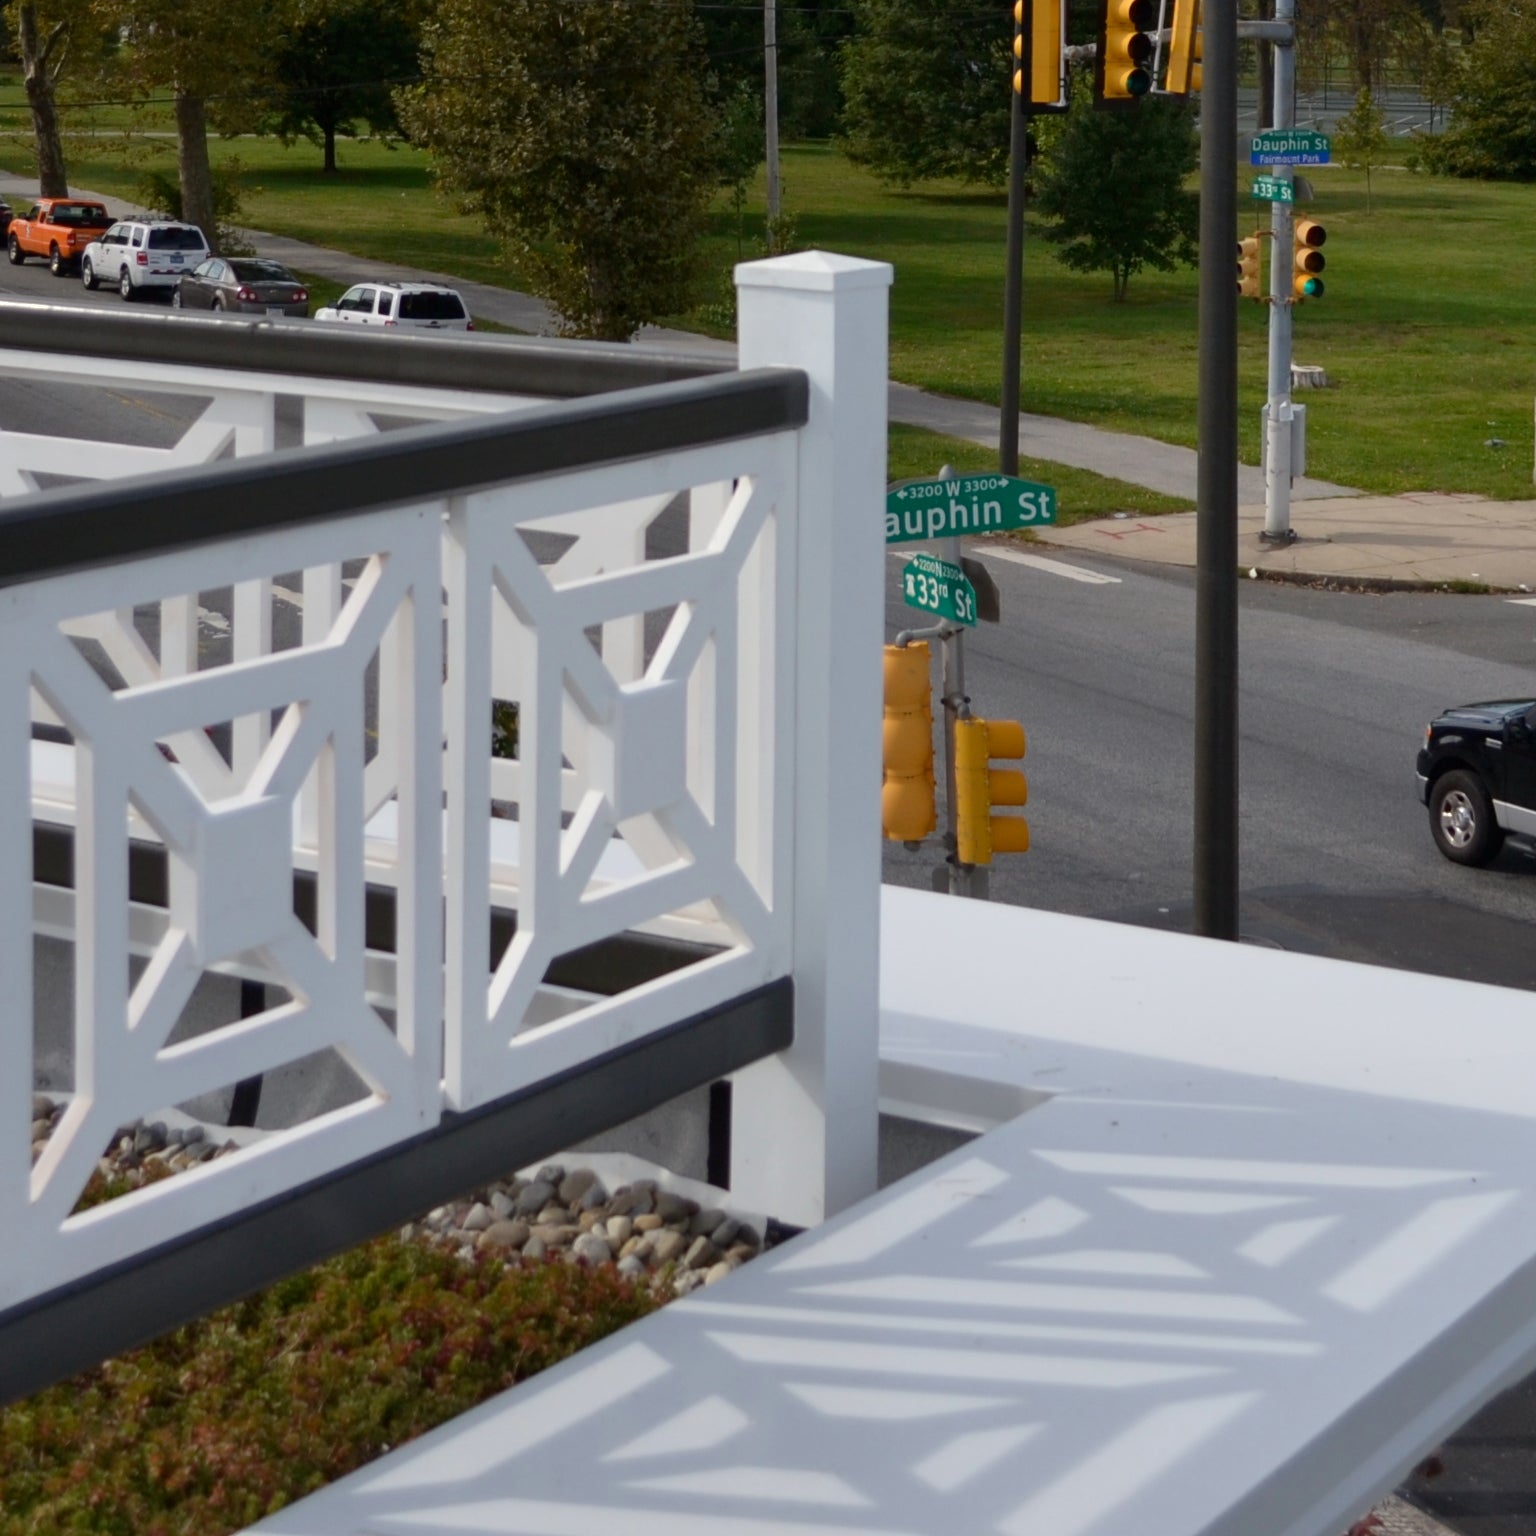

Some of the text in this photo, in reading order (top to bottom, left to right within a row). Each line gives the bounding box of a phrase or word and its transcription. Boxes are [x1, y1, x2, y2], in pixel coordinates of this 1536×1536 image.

[1252, 138, 1327, 153] Dauphin St
[1259, 154, 1320, 164] Fairmount Park
[1281, 186, 1292, 200] St
[909, 477, 998, 499] 3200 W 3300
[884, 492, 1051, 537] auphin St
[918, 557, 959, 581] 2200 N 2300
[917, 573, 972, 621] 33rd St
